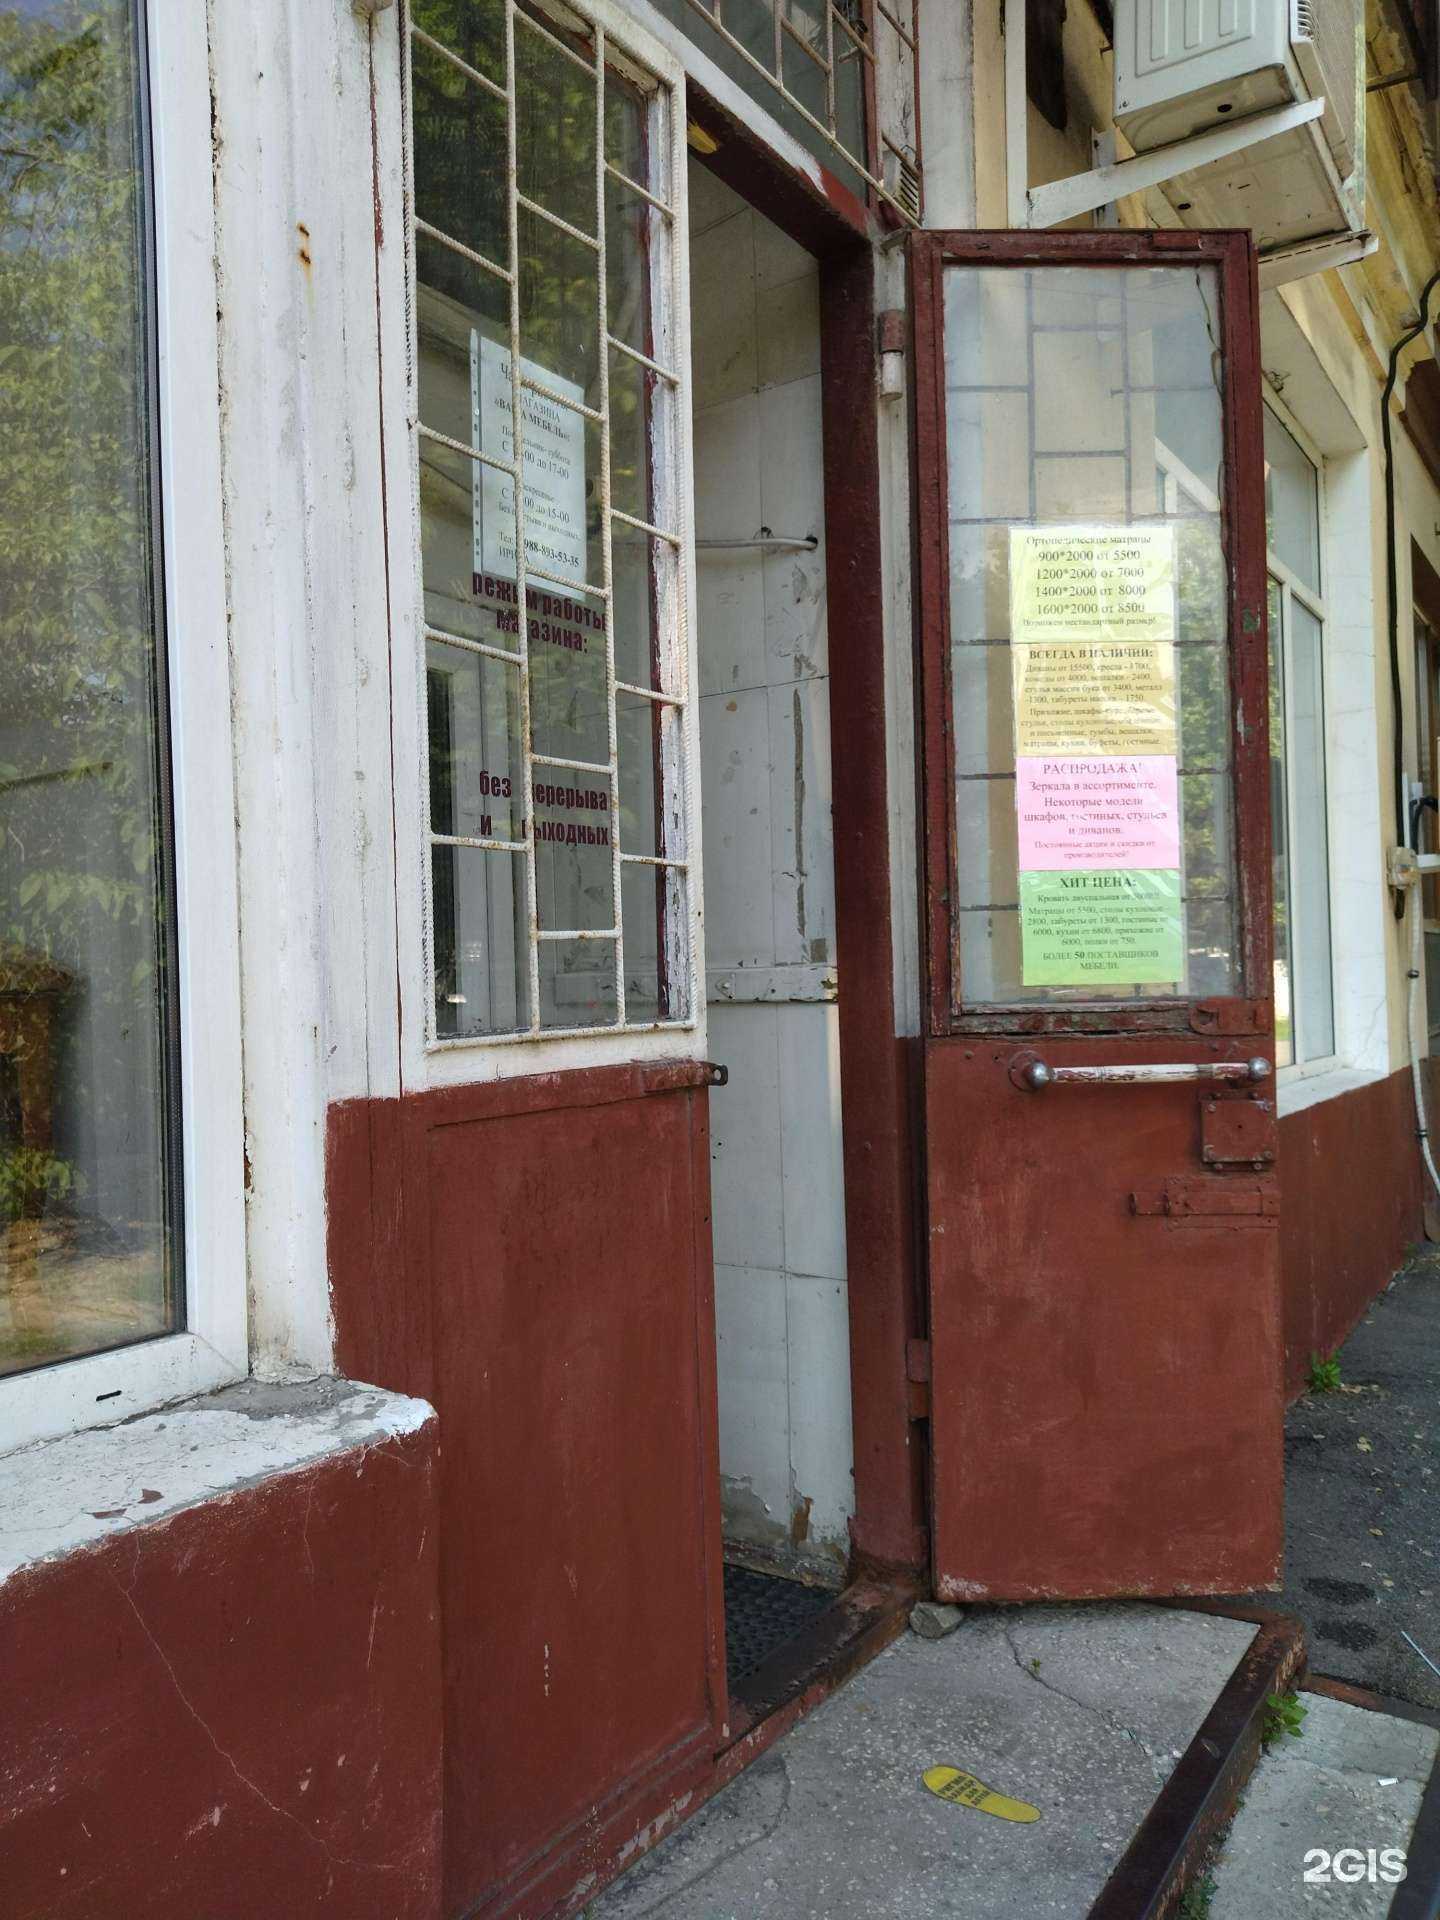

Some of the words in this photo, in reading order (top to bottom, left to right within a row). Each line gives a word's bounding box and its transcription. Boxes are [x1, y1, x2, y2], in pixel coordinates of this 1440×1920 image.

[495, 398, 526, 420] «ВАА
[1097, 552, 1109, 561] от
[1113, 550, 1141, 561] 5500
[1118, 567, 1144, 578] 7000
[1100, 588, 1112, 596] от
[1118, 585, 1146, 596] 8000
[1101, 606, 1113, 614] от
[1117, 603, 1145, 614] 8500
[496, 608, 588, 653] маазина:
[1029, 650, 1075, 660] ВСЕГДА
[1079, 649, 1087, 658] В
[479, 771, 512, 798] без
[530, 783, 608, 811] ерерыва
[1030, 781, 1071, 791] Зеркала
[1044, 797, 1102, 808] Некоторые
[1105, 799, 1143, 807] модели
[480, 815, 492, 836] и
[1060, 877, 1090, 889] ХИТ
[1092, 876, 1137, 888] ЦЕНА:
[1074, 951, 1085, 960] 50
